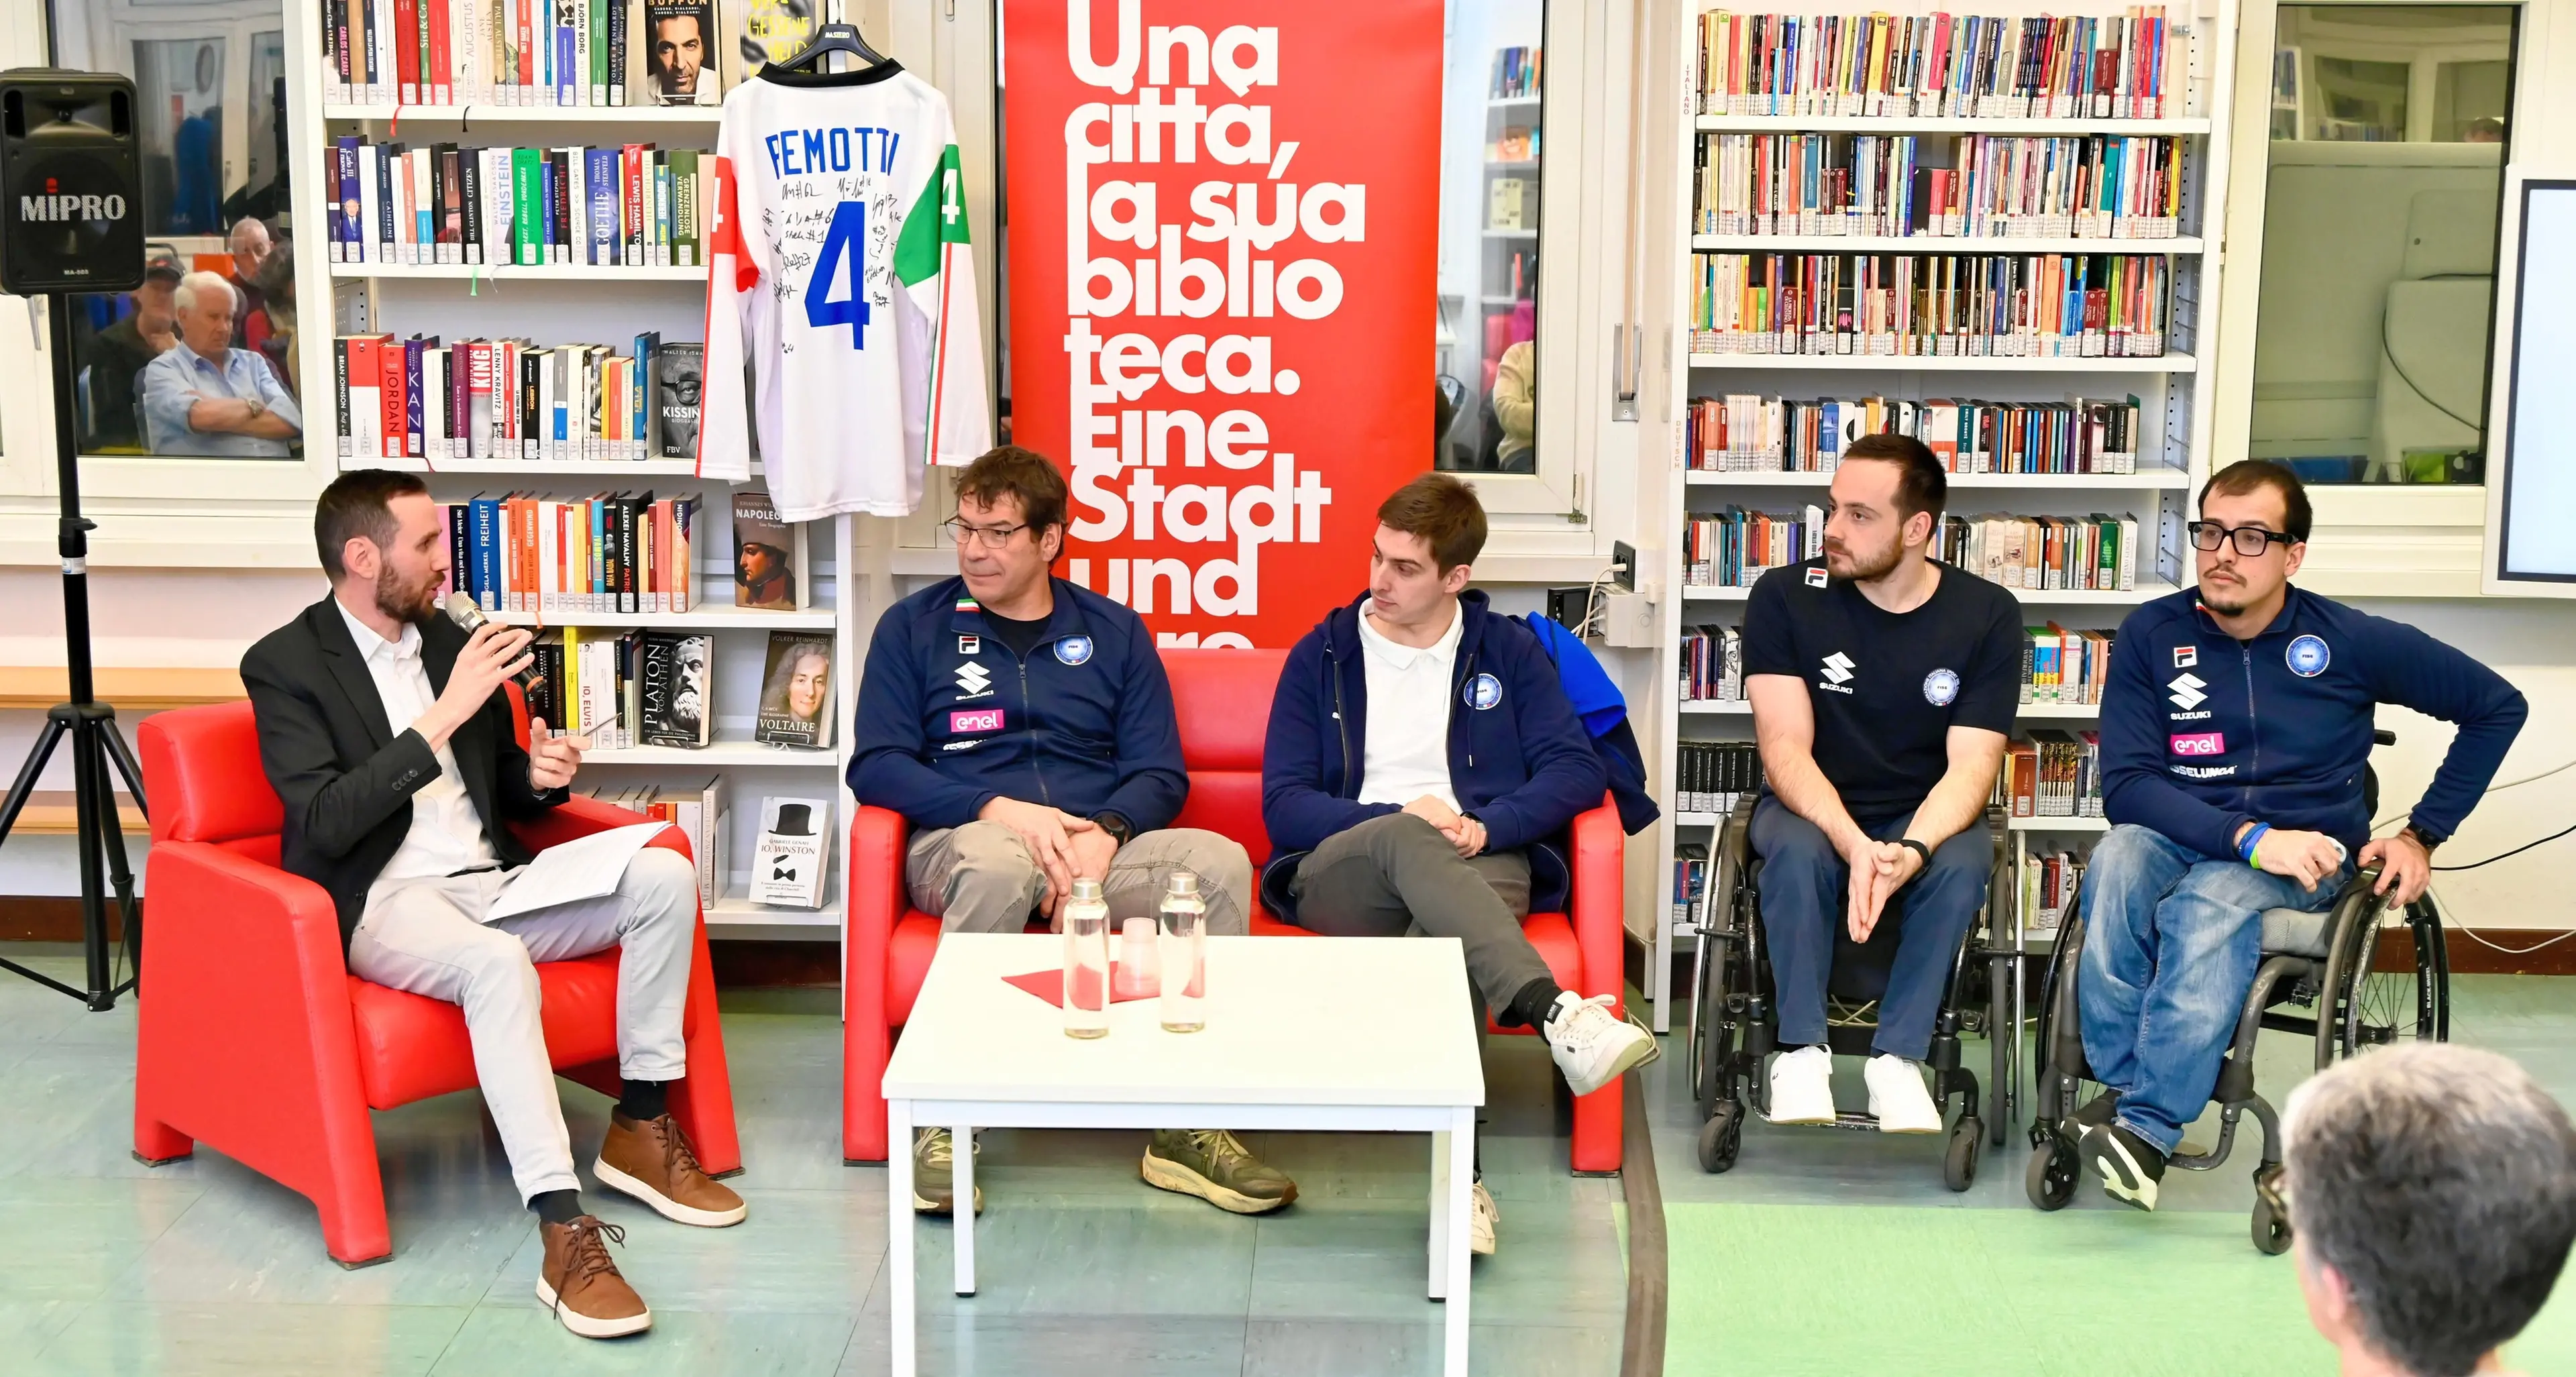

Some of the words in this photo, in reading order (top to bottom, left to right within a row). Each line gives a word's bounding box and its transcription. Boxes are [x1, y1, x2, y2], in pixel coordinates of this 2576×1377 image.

[419, 3, 427, 19] Co
[420, 20, 428, 30] &
[578, 3, 586, 29] BJÖRN
[747, 14, 810, 38] GESSENE
[340, 26, 348, 49] CARLOS
[420, 32, 429, 48] Sisi
[464, 3, 474, 57] AUGUSTUS
[1067, 0, 1279, 87] Una
[340, 50, 348, 76] ALCARAZ
[1682, 64, 1690, 115] ITALIANO
[1064, 82, 1301, 180] città,
[341, 171, 346, 180] re
[466, 168, 474, 198] CITIZEN
[498, 155, 511, 225] EINSTEIN
[520, 167, 528, 201] VORDENKER
[632, 175, 641, 204] LEWIS
[21, 192, 127, 222] MIPRO
[559, 170, 568, 229] FRIEDRICH
[645, 181, 654, 221] HEINRICH
[657, 180, 667, 219] HERRNDORF
[677, 176, 685, 236] VERWANDLUNG
[683, 178, 691, 234] GRENZENLOSE
[942, 168, 960, 225] 4
[1067, 145, 1158, 243] la
[1185, 179, 1366, 243] sua
[520, 202, 528, 225] REBELL.
[594, 191, 610, 245] GOETHE
[633, 206, 641, 245] HAMILTO
[521, 227, 529, 243] ARZT.
[805, 201, 870, 350] 4
[1067, 225, 1344, 320] biblio
[473, 349, 491, 388] KING
[1064, 318, 1301, 395] teca.
[386, 370, 400, 433] JORDAN
[407, 372, 421, 429] KAN
[494, 377, 502, 410] KRAVITZ
[663, 406, 700, 419] KISSIN
[1070, 384, 1269, 470] Eine
[736, 508, 782, 520] NAPOLEO
[1068, 453, 1332, 543] Stadt
[479, 504, 490, 547] FREIHEIT
[526, 509, 534, 547] GEGENWIND
[622, 505, 631, 531] ALEXEI
[606, 558, 614, 573] NADAL
[622, 533, 631, 567] NAVALNY
[456, 568, 464, 593] videogio
[606, 573, 614, 586] RAFA
[622, 568, 631, 593] PATRIO
[1069, 536, 1258, 616] und
[644, 644, 660, 724] PLATON
[659, 646, 669, 690] ATHEN
[582, 685, 591, 698] IO,
[1819, 682, 1853, 694] SUZUKI
[583, 700, 592, 727] ELVIS
[759, 718, 815, 732] VOLTAIRE
[956, 712, 998, 730] enel
[2170, 710, 2211, 720] SUZUKI
[2174, 735, 2217, 753] enel
[761, 844, 772, 853] IO,
[773, 845, 816, 855] WINSTON
